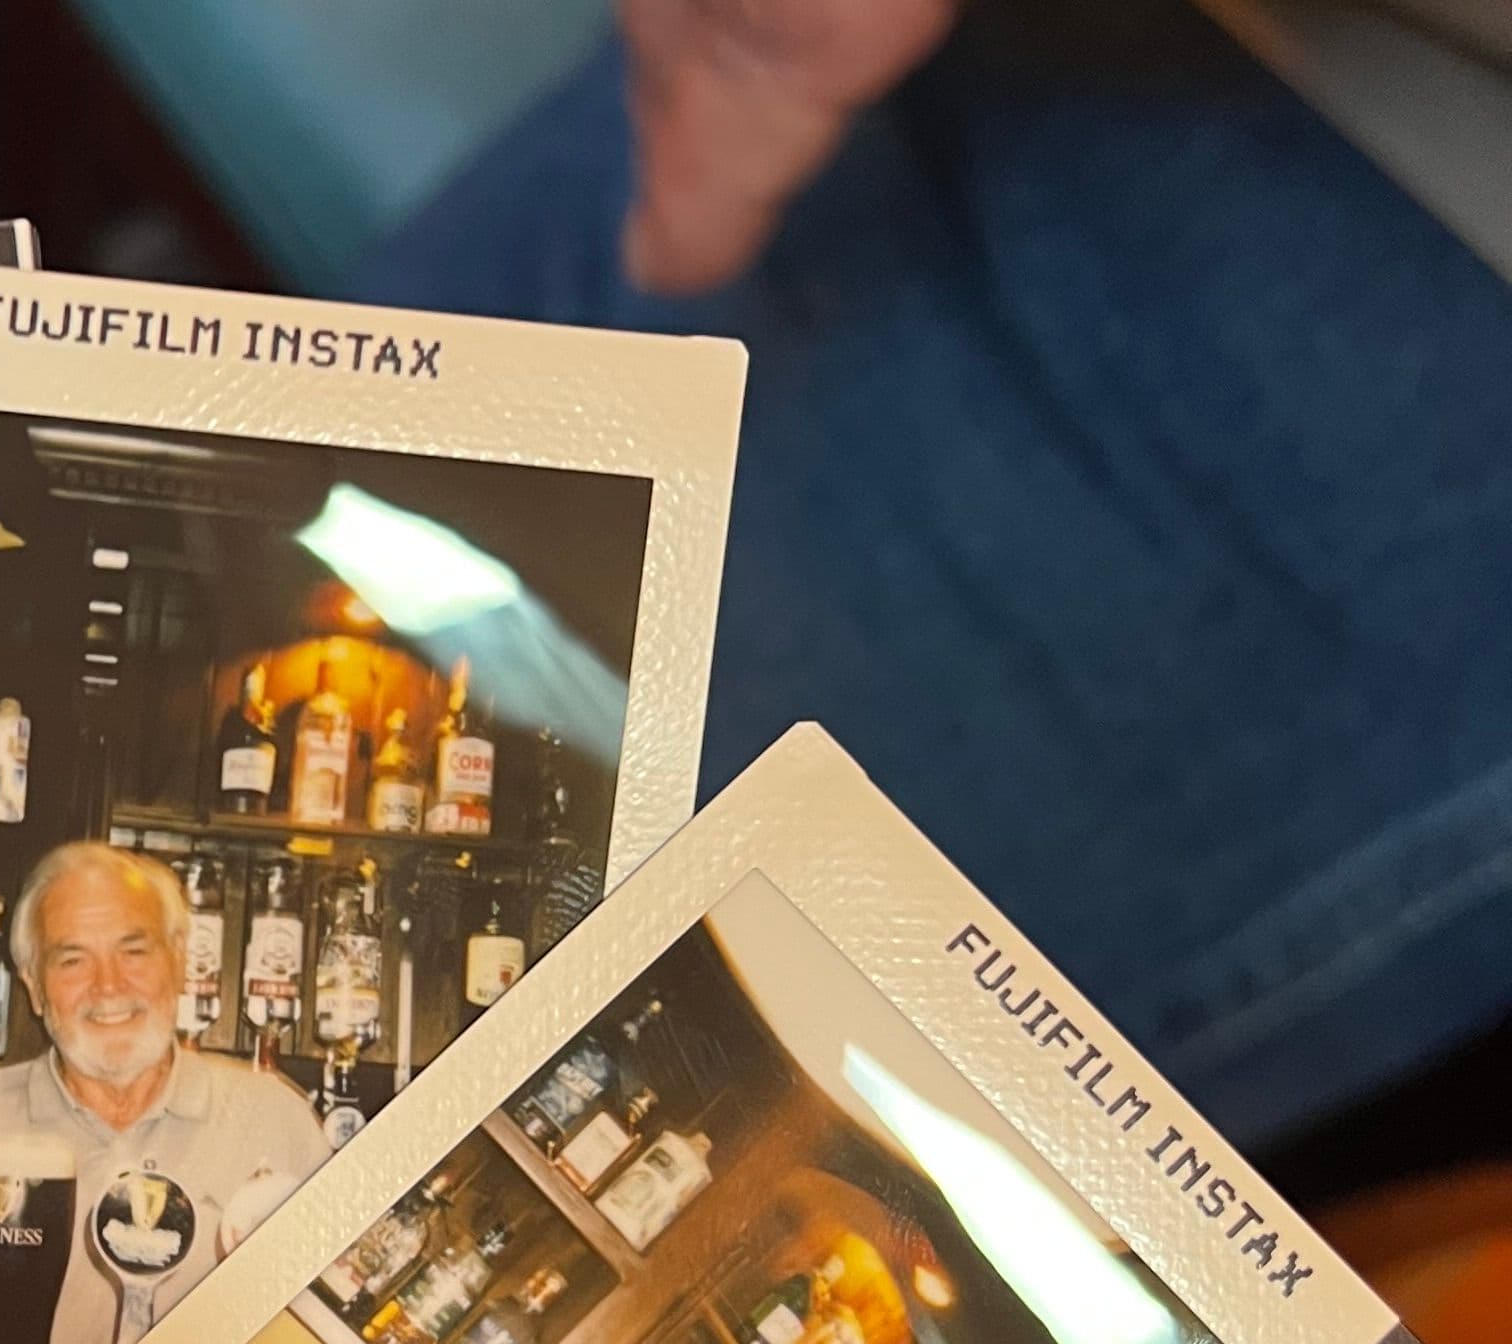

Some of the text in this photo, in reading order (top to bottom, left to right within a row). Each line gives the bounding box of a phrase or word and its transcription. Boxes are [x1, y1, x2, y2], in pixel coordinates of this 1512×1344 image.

[241, 321, 443, 380] INSTAX
[944, 923, 1315, 1299] FUJIFILM INSTAX
